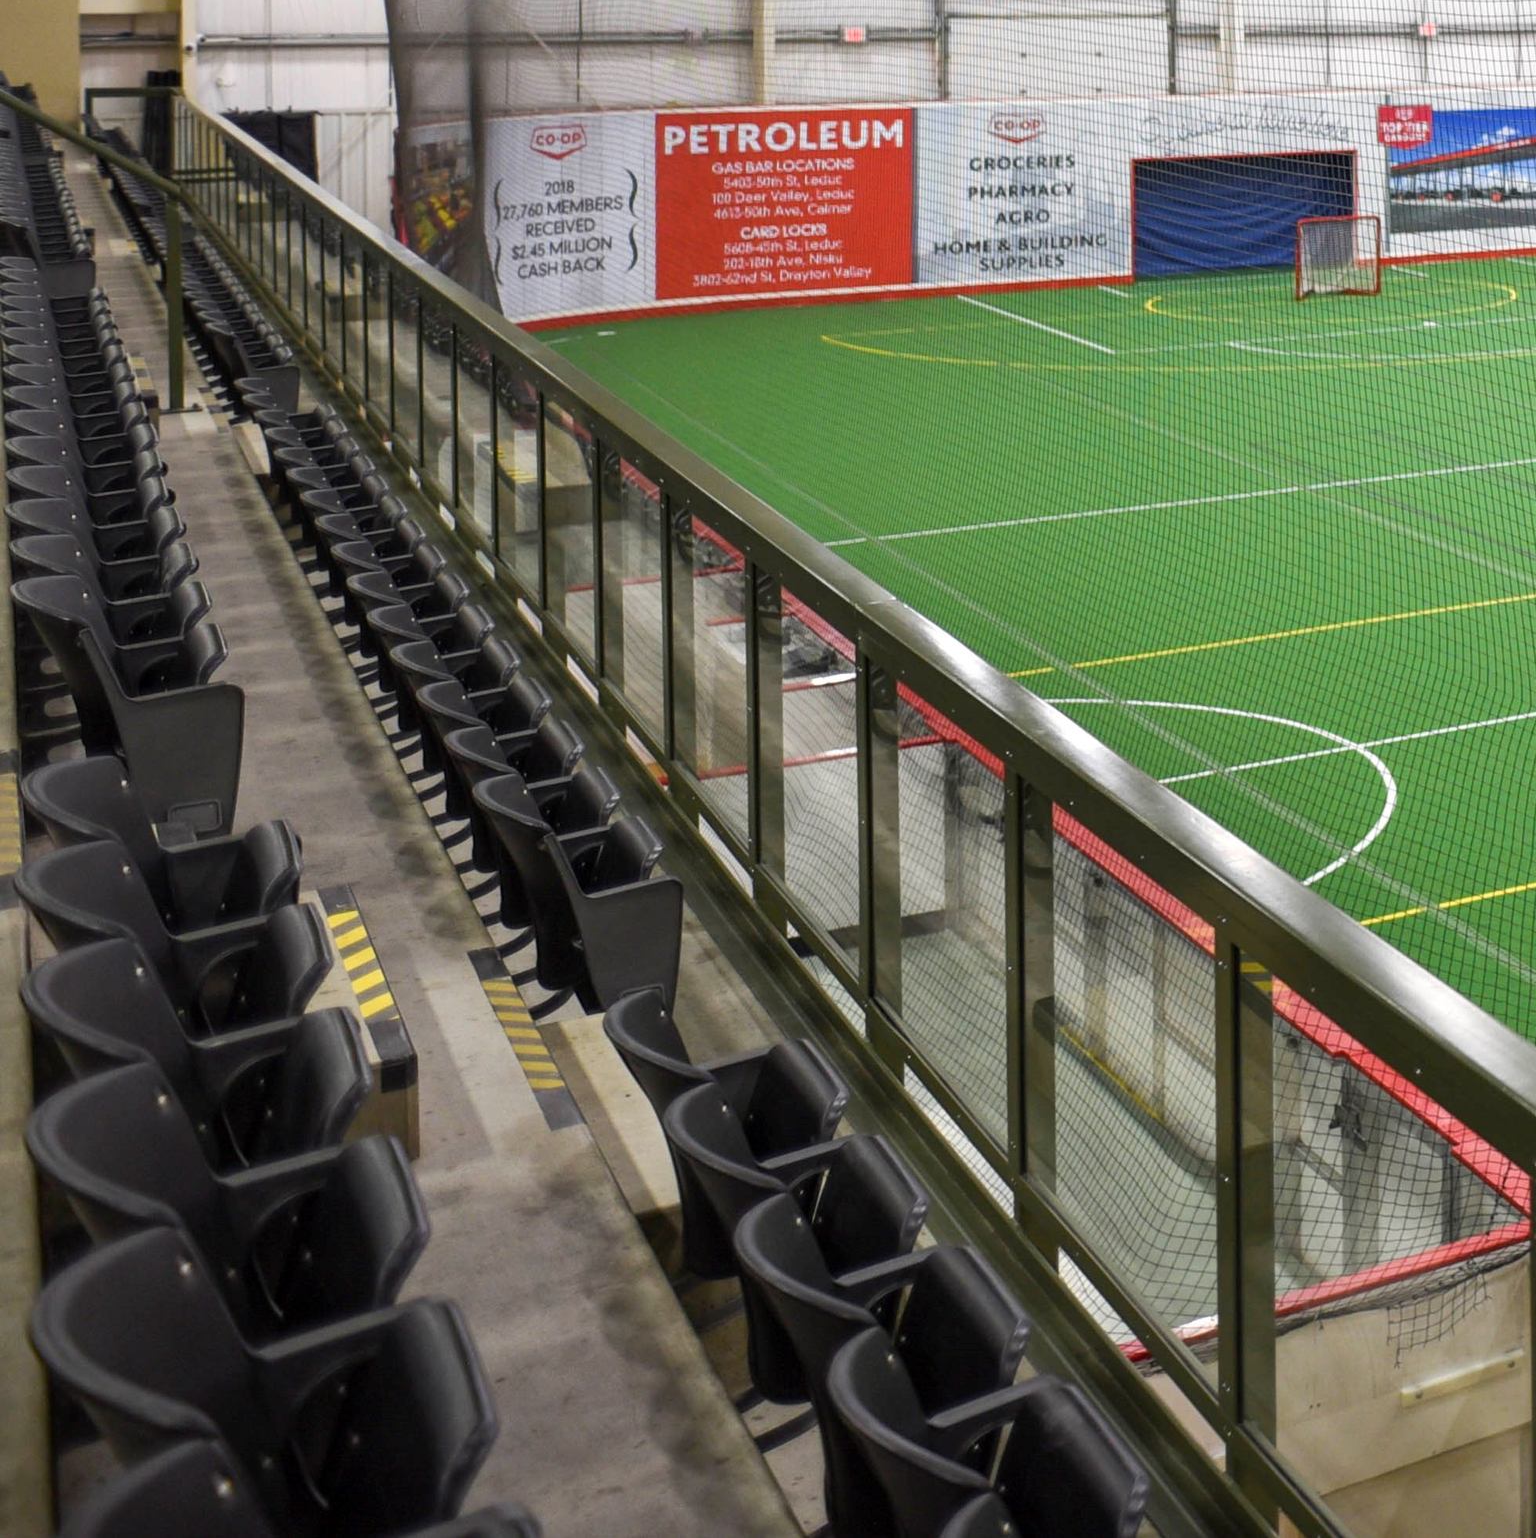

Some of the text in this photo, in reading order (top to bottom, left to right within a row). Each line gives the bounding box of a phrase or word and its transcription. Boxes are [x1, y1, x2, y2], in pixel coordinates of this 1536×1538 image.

[1381, 122, 1402, 133] TOP
[664, 119, 903, 155] PETROLEUM
[712, 157, 854, 174] GAS BAR LOCATIONS
[969, 155, 1075, 171] GROCERIES
[545, 180, 575, 196] 2018
[804, 174, 842, 186] Leduc
[735, 192, 766, 204] Deer
[816, 189, 854, 200] Leduc
[969, 183, 1074, 200] PHARMACY
[503, 196, 624, 221] 27,760 MEMBERS
[996, 209, 1050, 224] AGRO
[526, 218, 596, 237] RECEIVED
[741, 223, 827, 239] CARD LOCKS
[512, 236, 613, 260] $2.45 MILLION
[805, 239, 842, 251] Leduc
[934, 234, 1107, 255] HOME & BUILDING
[517, 257, 606, 279] CASH BACK
[980, 254, 1065, 271] SUPPLIES
[780, 268, 830, 283] Drayton
[833, 266, 872, 280] Valley
